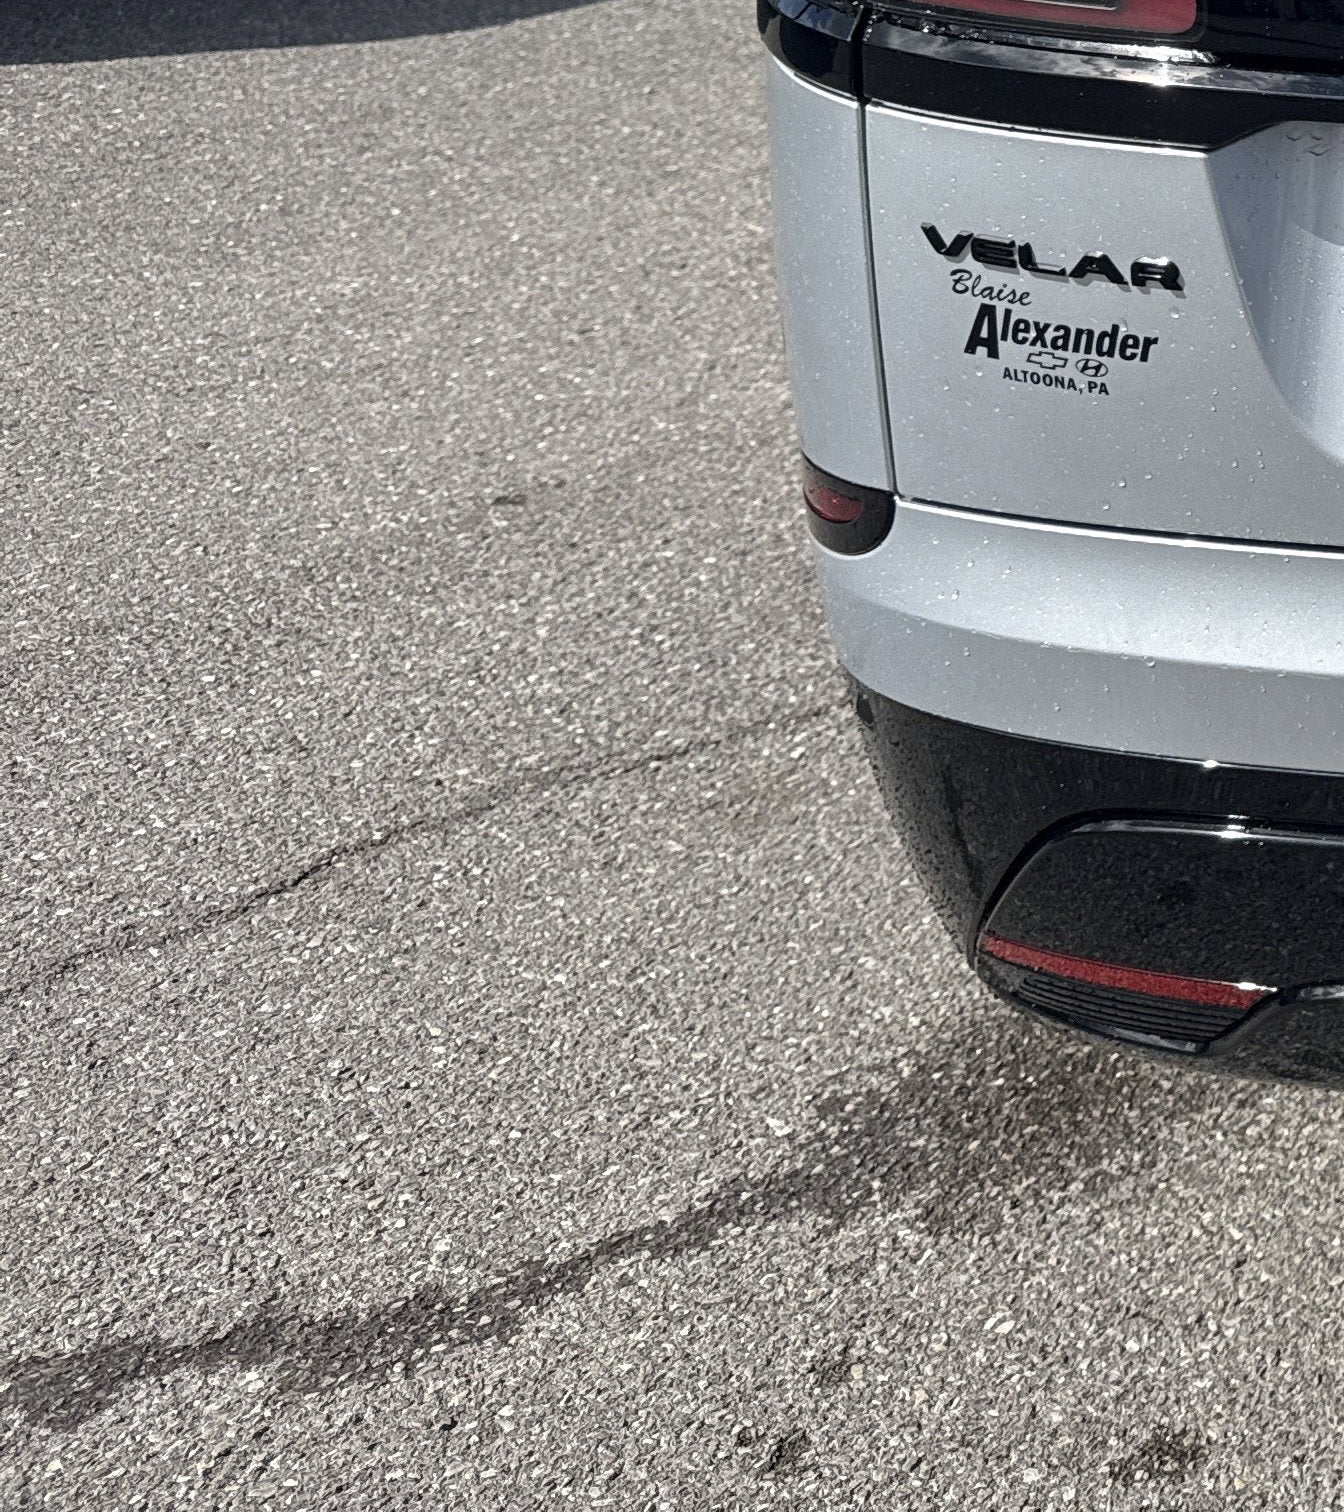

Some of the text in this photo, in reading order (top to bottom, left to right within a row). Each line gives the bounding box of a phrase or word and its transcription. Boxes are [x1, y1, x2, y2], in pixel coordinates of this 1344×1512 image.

[921, 222, 1185, 294] VELAR
[950, 268, 1032, 306] Blaise
[964, 302, 1159, 362] Alexander
[1003, 367, 1110, 396] ALTOONA, PA
